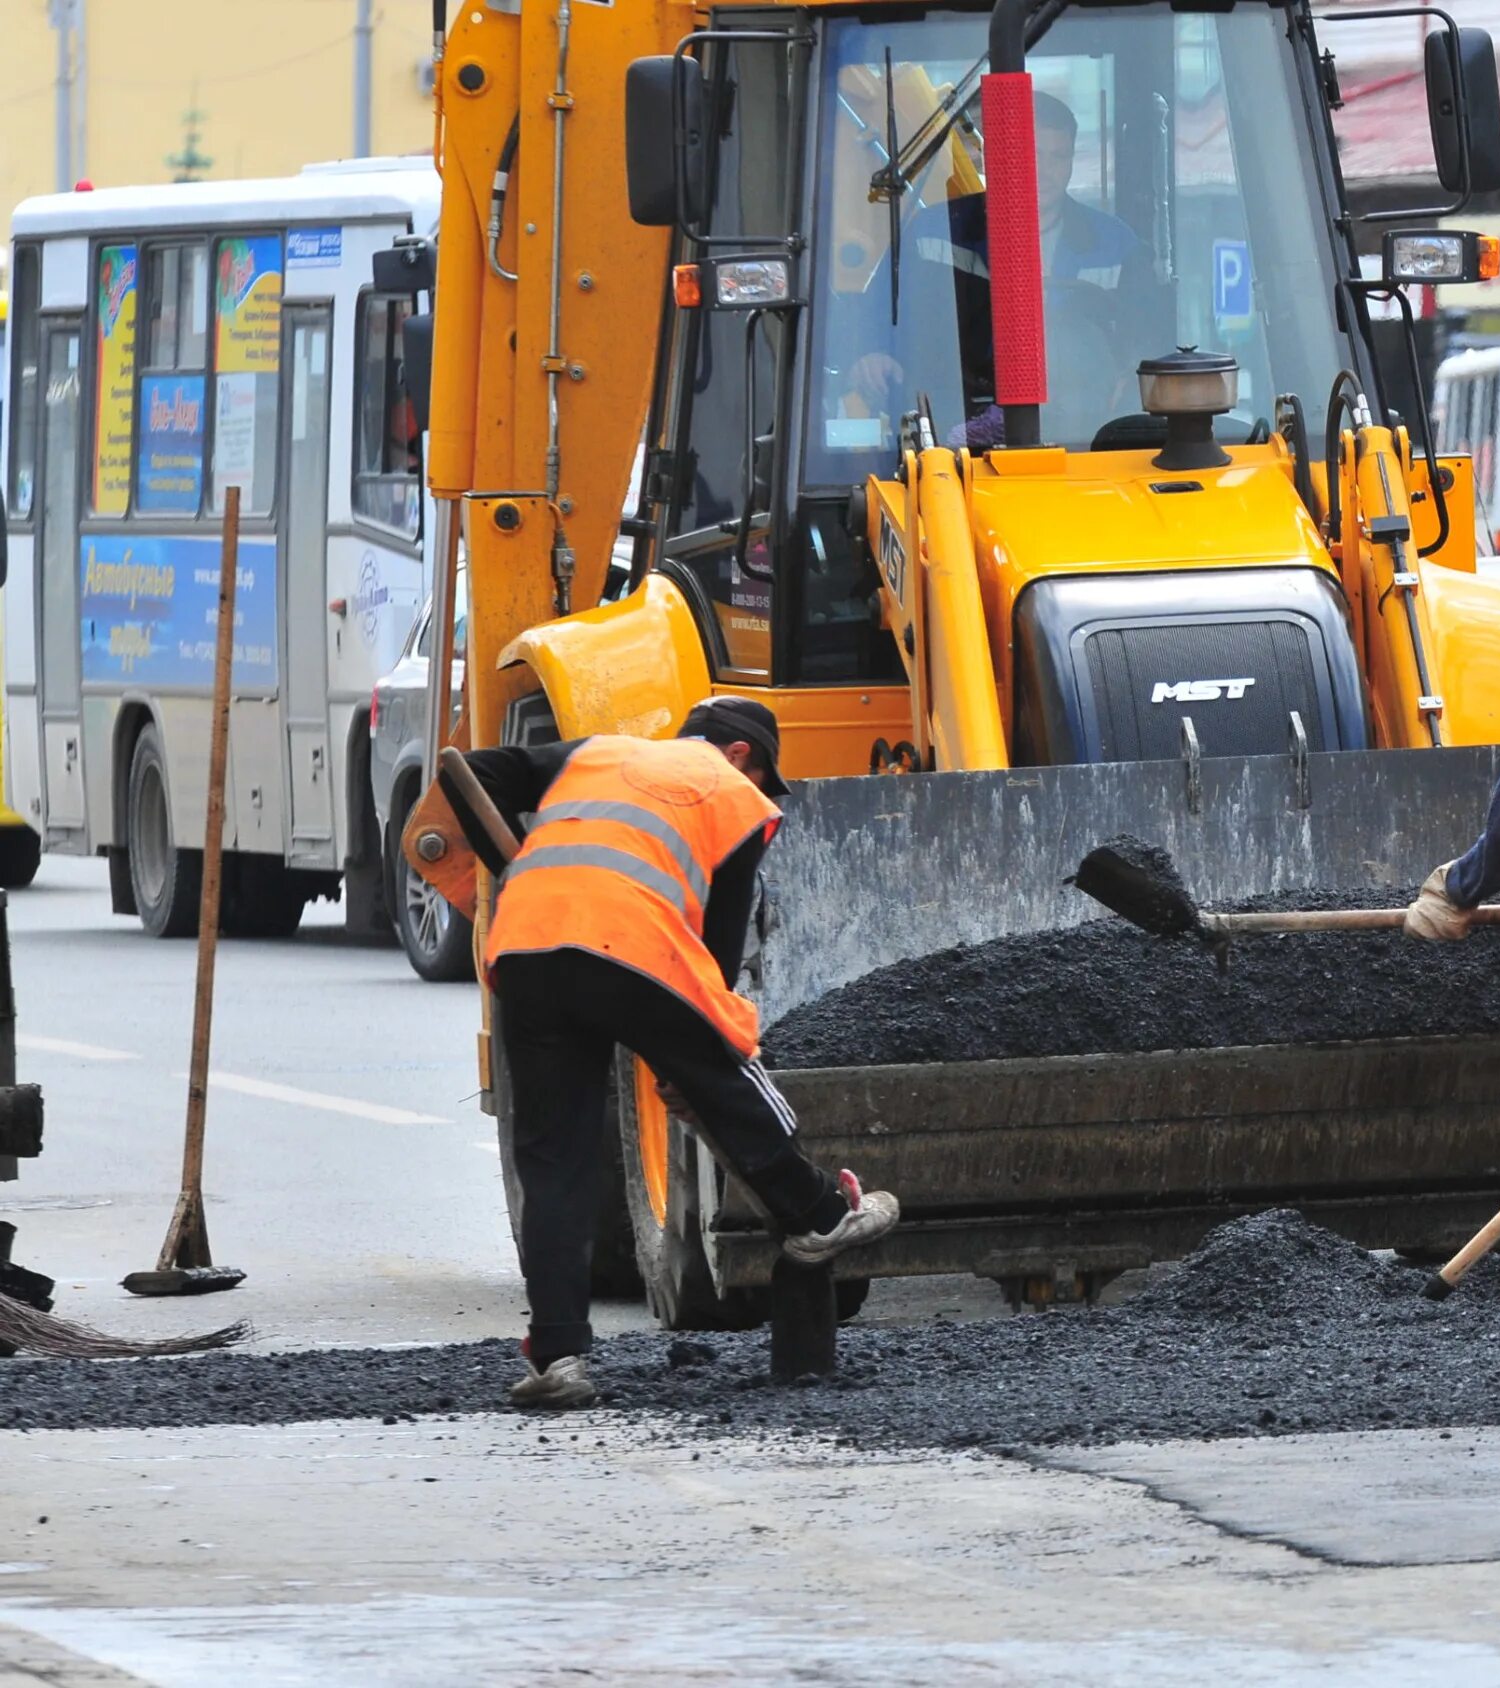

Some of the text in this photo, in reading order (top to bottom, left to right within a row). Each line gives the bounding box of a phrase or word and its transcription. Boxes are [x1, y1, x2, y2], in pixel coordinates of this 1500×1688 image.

[1220, 249, 1242, 308] P
[83, 544, 175, 611] Автобусные
[1151, 678, 1255, 703] MST
